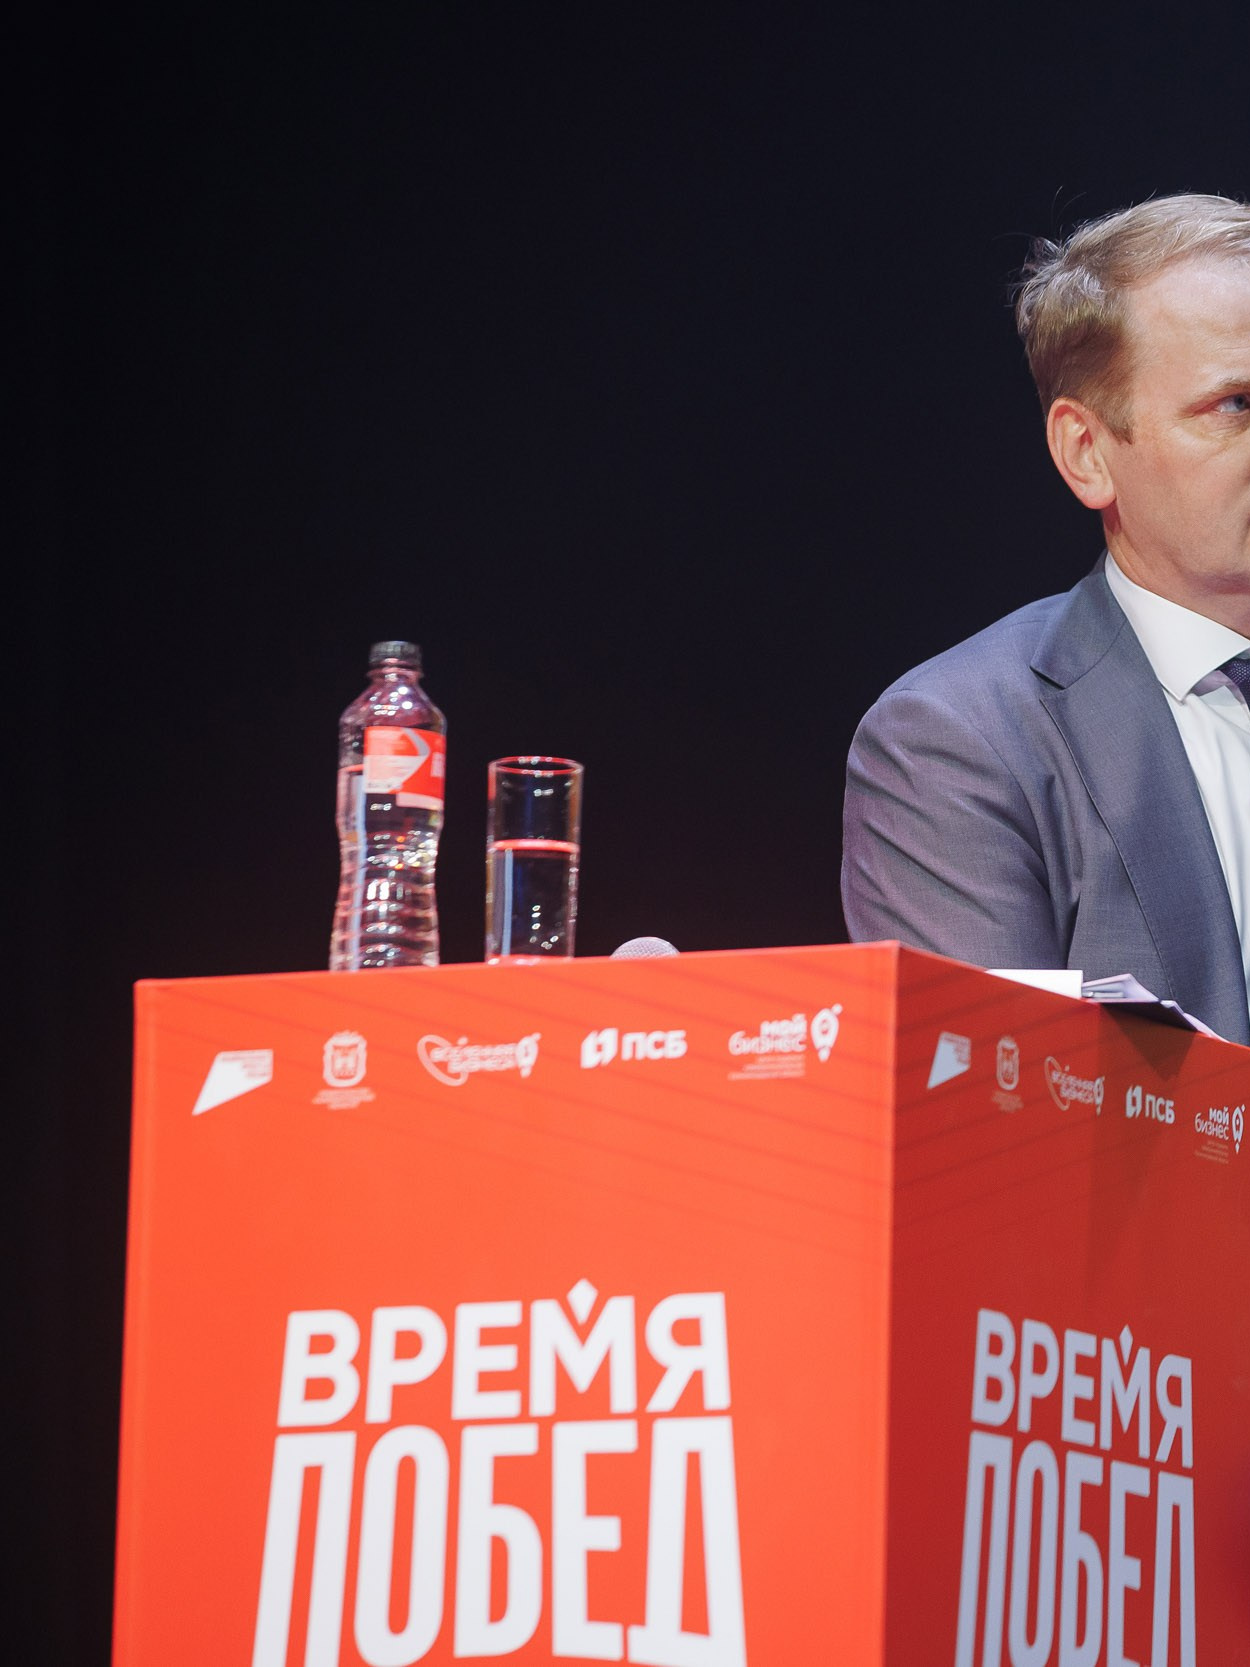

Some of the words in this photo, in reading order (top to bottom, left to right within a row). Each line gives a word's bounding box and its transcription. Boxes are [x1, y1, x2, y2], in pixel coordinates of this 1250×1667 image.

[621, 1029, 688, 1061] ПСБ
[1145, 1093, 1176, 1125] ПСБ
[1208, 1106, 1230, 1126] мой
[1194, 1112, 1230, 1141] бизнес
[277, 1278, 732, 1428] ВРЕМЯ
[970, 1307, 1194, 1470] ВРЕМЯ
[251, 1415, 748, 1667] ПОБЕД
